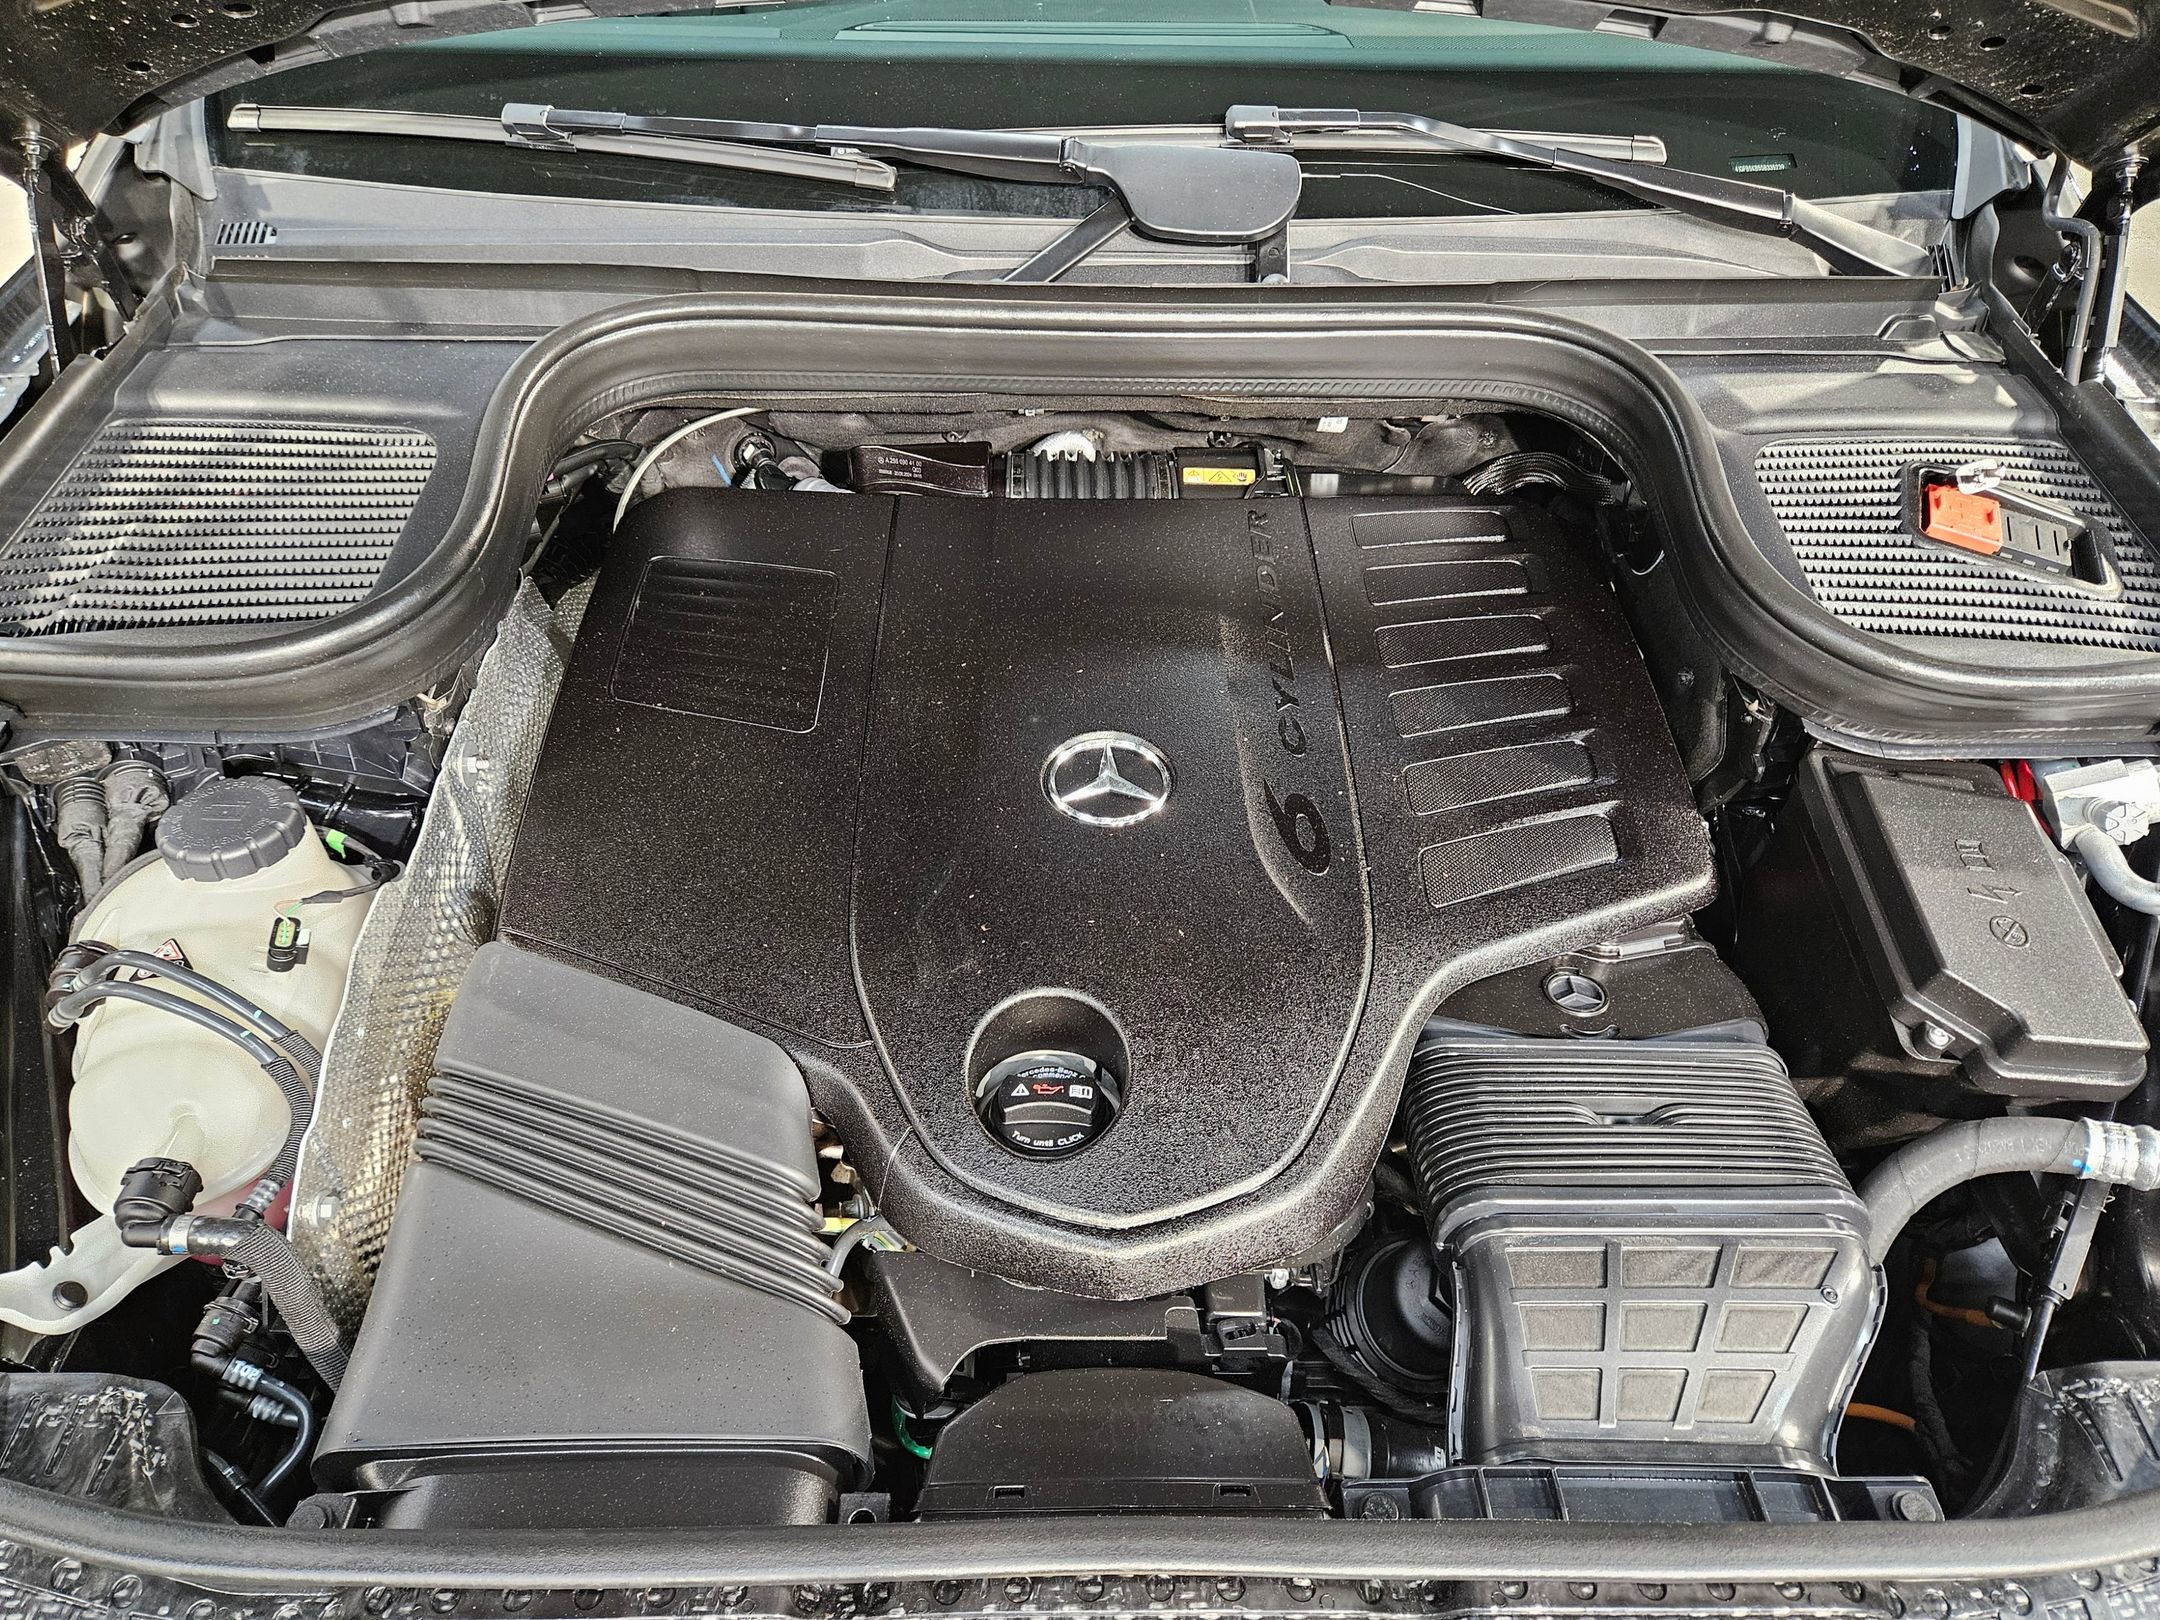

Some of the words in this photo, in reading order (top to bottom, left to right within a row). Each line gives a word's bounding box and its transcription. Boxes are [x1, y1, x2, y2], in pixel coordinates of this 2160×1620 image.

[1246, 509, 1307, 758] CYLINDER
[1263, 778, 1331, 876] 6
[1011, 1130, 1031, 1144] Turn
[1033, 1139, 1054, 1147] until
[1057, 1131, 1085, 1146] CLICK
